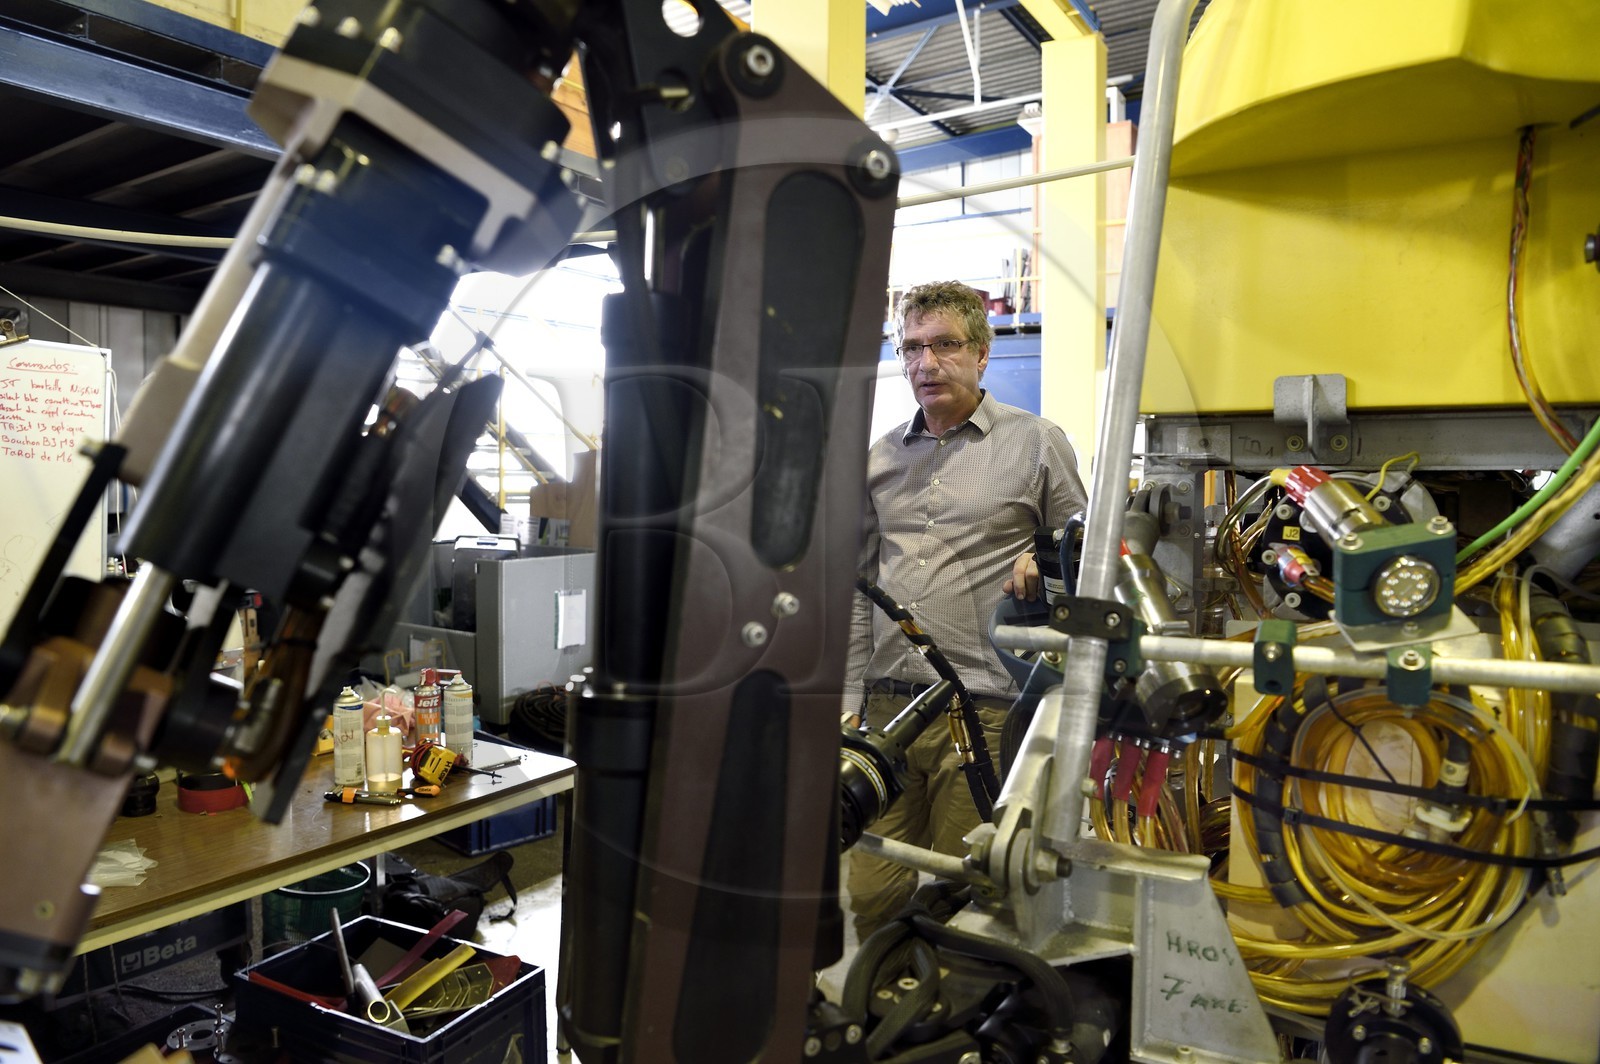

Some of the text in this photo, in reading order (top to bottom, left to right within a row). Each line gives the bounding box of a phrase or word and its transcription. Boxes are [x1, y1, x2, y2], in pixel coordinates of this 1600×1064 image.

[1, 435, 41, 446] Bouchon
[1285, 528, 1299, 539] J2
[143, 935, 198, 967] Beta
[1160, 974, 1192, 1001] 7
